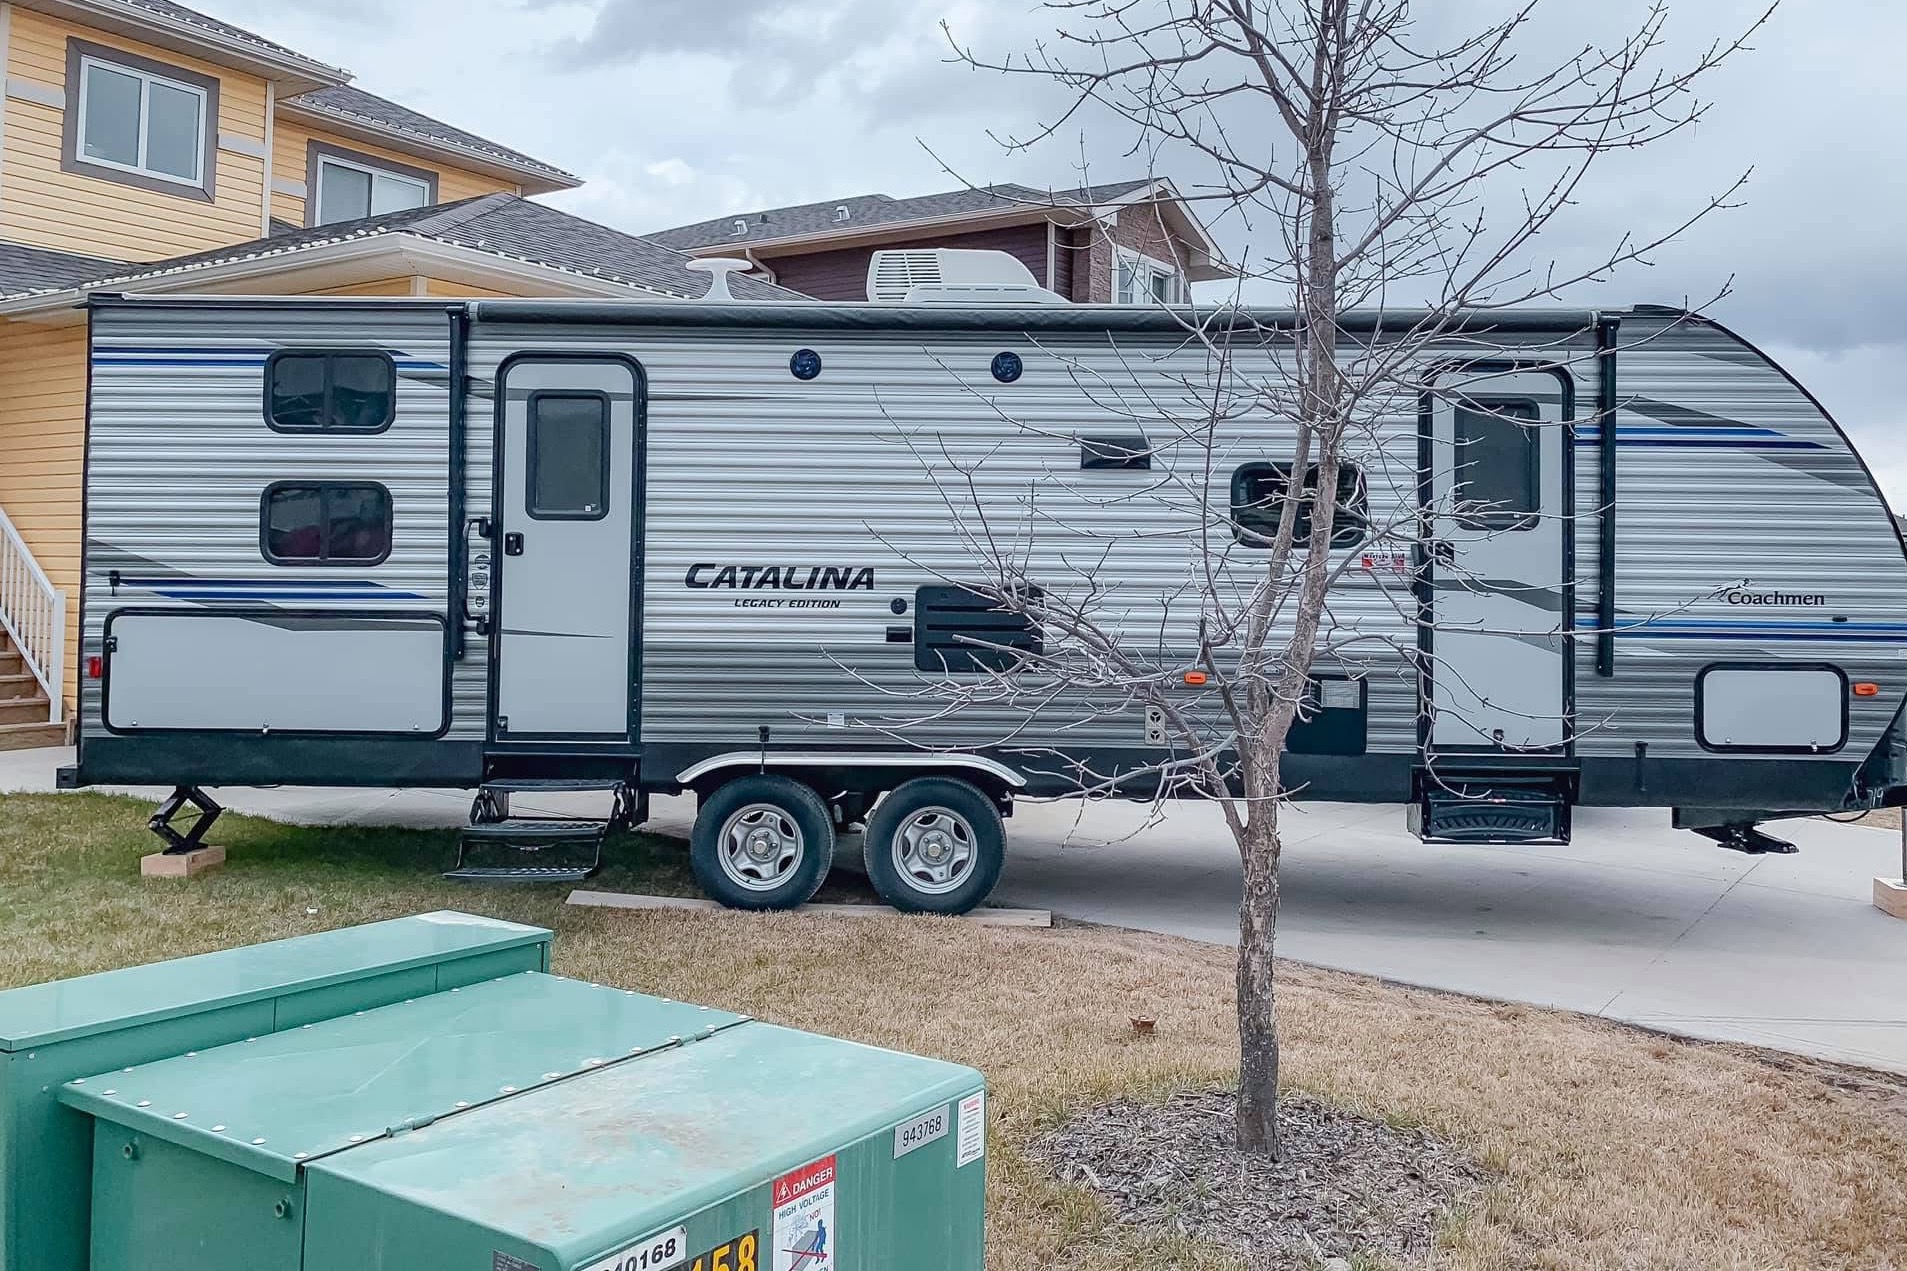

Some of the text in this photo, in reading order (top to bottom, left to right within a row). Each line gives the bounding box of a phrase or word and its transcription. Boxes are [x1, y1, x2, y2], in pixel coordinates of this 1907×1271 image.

[685, 563, 875, 590] CATALINA
[734, 598, 841, 609] LEGACY EDITION
[1727, 590, 1825, 606] Coachmen
[902, 1115, 942, 1147] 943768
[792, 1166, 833, 1195] DANGER
[778, 1188, 830, 1221] HIGH VOLTAGE
